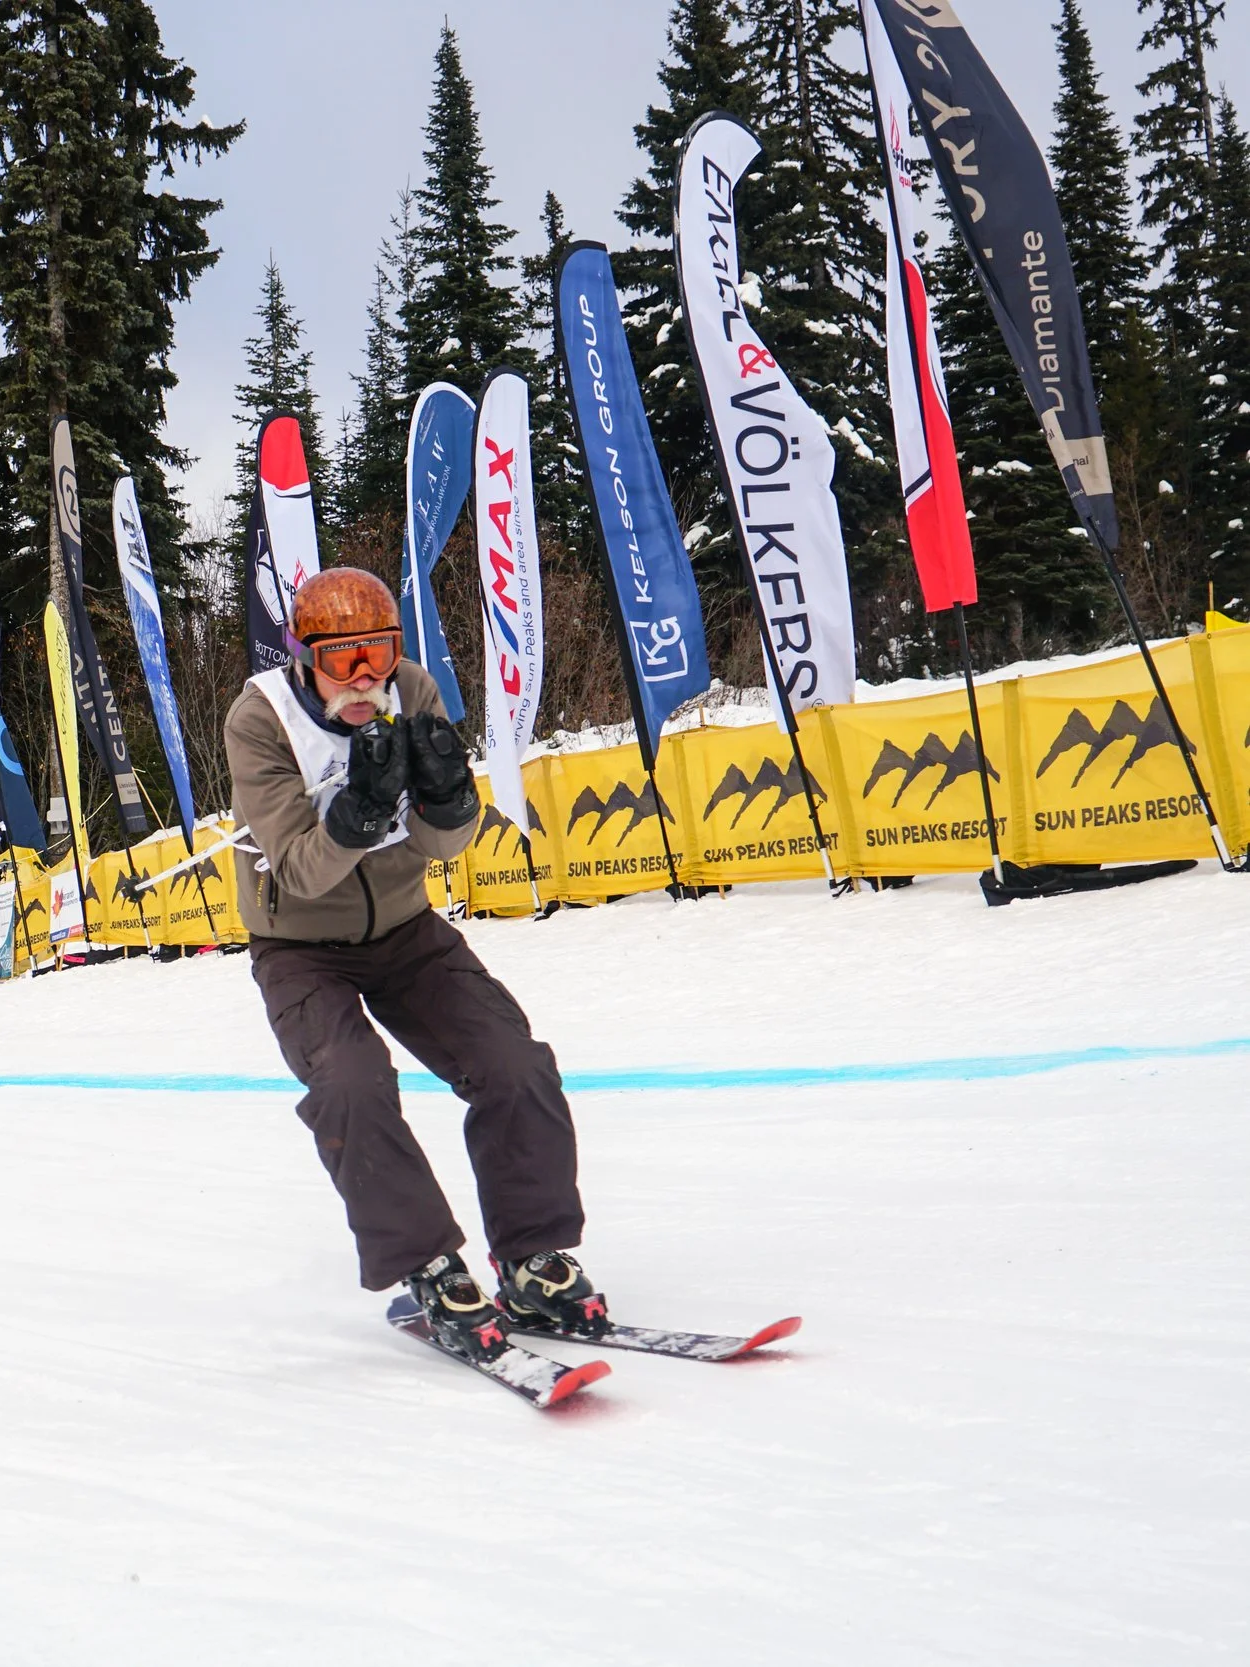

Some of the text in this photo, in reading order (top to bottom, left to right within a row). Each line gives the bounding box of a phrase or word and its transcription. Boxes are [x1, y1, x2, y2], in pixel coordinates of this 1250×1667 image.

[738, 344, 776, 379] &
[579, 294, 653, 603] KELSON GROUP
[513, 495, 523, 536] since
[517, 541, 528, 574] area
[485, 436, 521, 722] E/MAX
[518, 577, 531, 607] and
[522, 611, 536, 656] Peaks
[641, 615, 682, 666] KG
[255, 639, 291, 664] BOTTOM
[525, 662, 536, 692] Sun
[514, 697, 531, 746] erving
[1034, 809, 1076, 832] SUN
[1081, 802, 1142, 828] PEAKS
[866, 827, 899, 847] SUN
[901, 822, 949, 845] PEAKS
[703, 847, 734, 863] SUN
[735, 839, 786, 861] PEAKS
[427, 860, 459, 880] RESRT
[476, 864, 553, 887] SUN PEAKS ESORT
[568, 861, 592, 878] SUN
[595, 857, 638, 876] PEAKS
[87, 921, 103, 934] ESORT
[122, 918, 140, 930] PEAKS
[140, 915, 161, 928] ESORT
[170, 911, 182, 924] SUN
[183, 907, 203, 919] PEAKS
